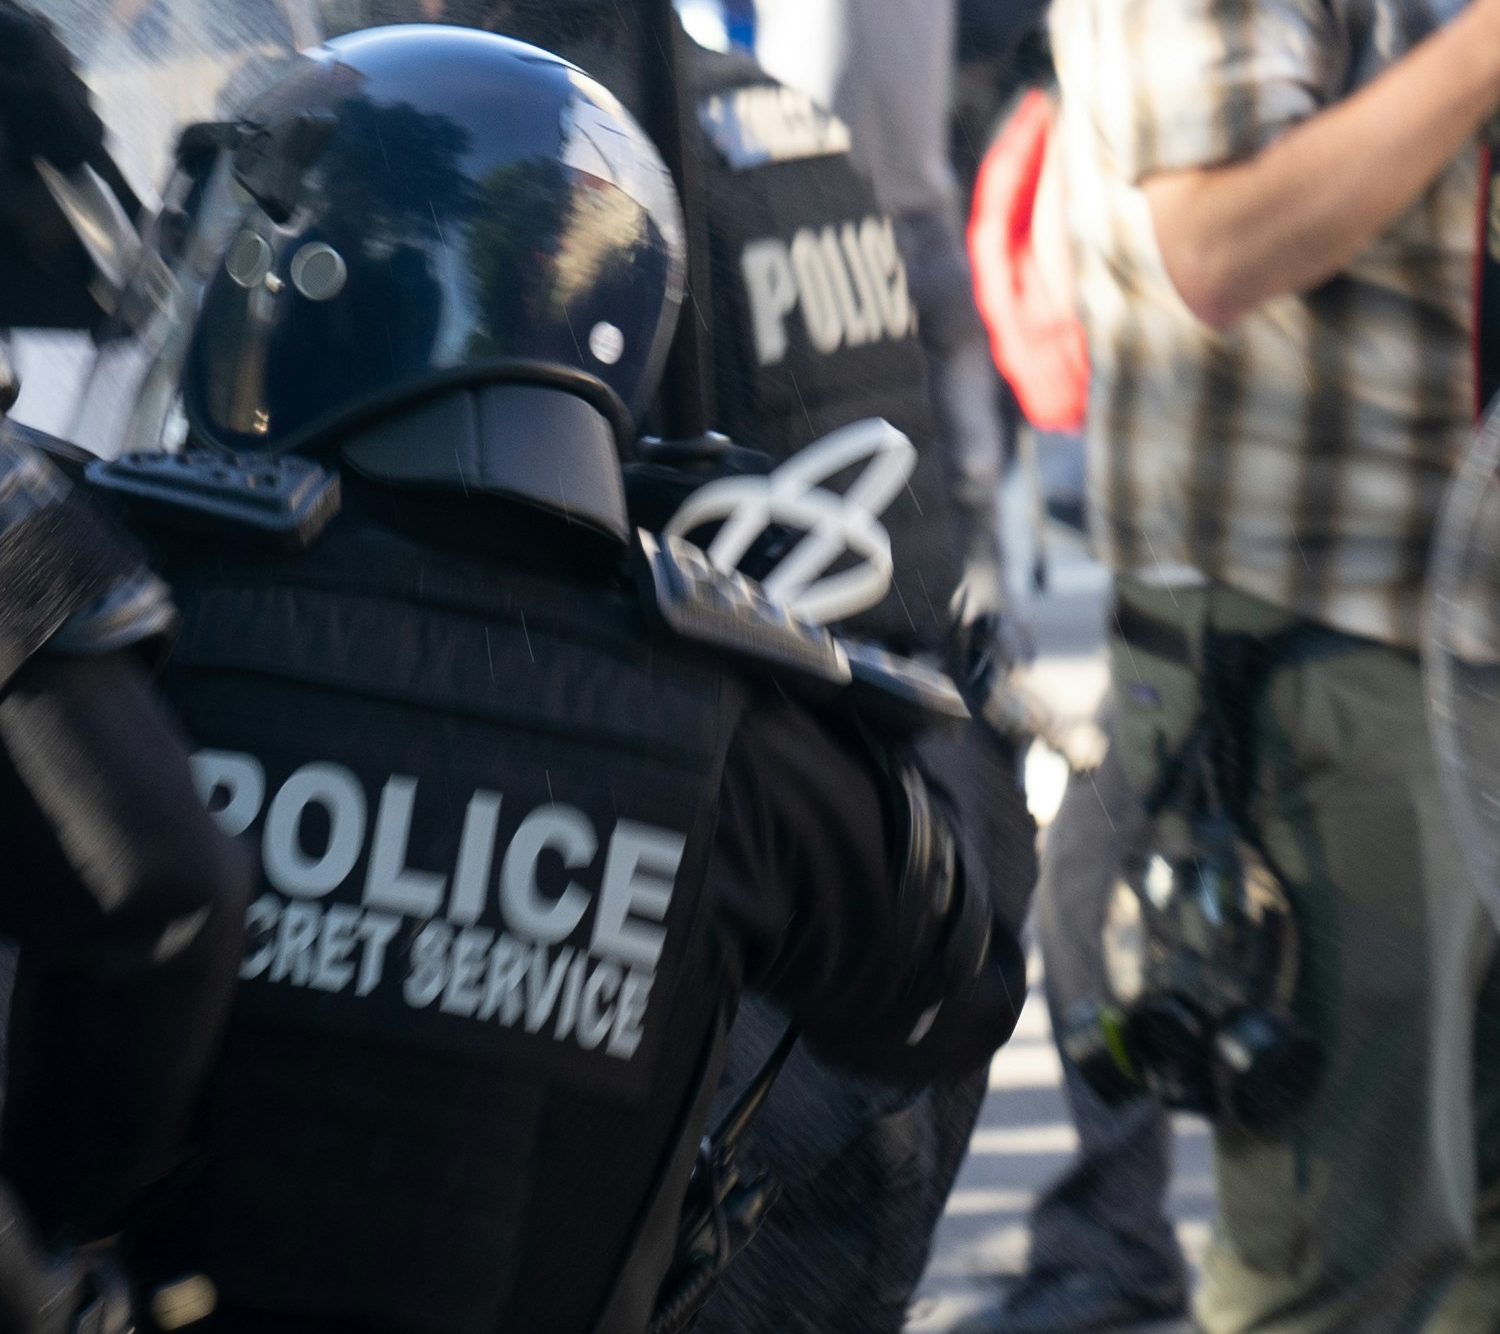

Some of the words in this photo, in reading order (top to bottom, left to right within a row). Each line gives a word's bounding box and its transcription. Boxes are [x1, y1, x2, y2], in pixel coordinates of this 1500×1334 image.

[740, 214, 919, 367] POLIC
[239, 892, 403, 997] CRET
[402, 917, 657, 1062] SERVICE
